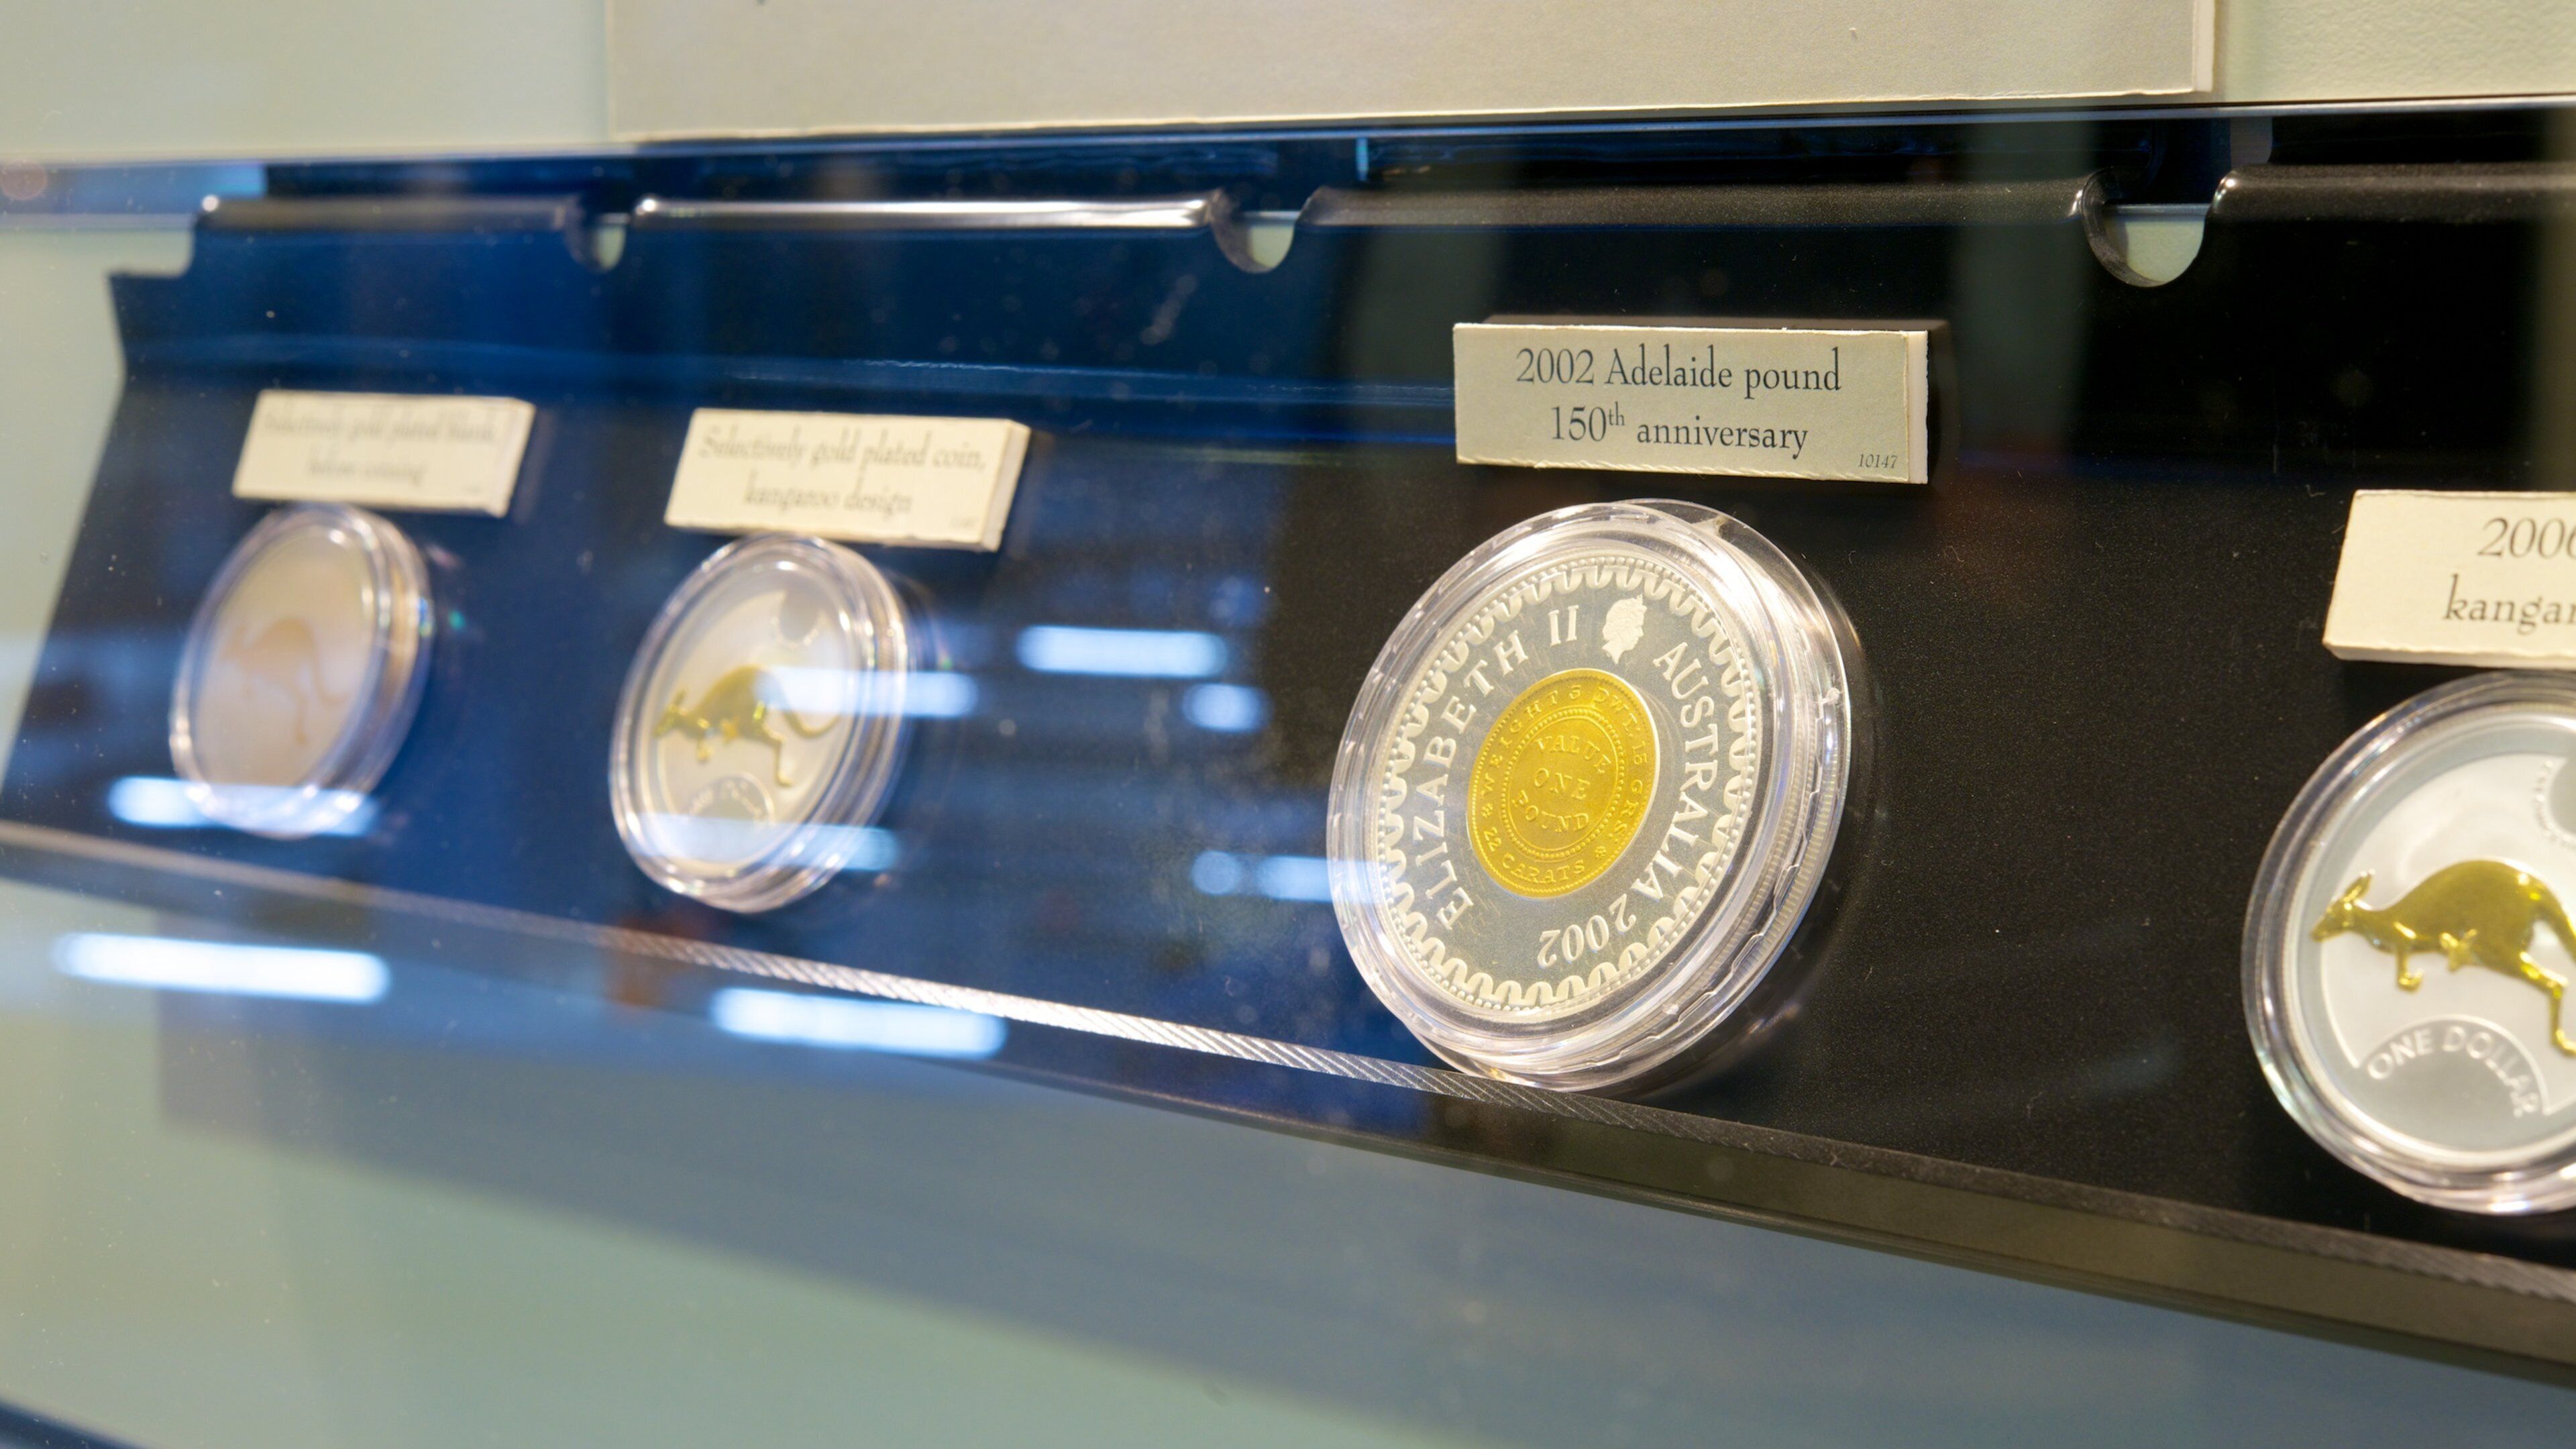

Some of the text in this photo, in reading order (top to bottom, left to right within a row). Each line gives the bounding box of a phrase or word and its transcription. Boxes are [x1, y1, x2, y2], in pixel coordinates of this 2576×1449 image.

[1515, 343, 1842, 400] 2002 Adelaide pound
[808, 426, 862, 471] gold
[859, 429, 932, 474] plated
[1550, 400, 1809, 460] 150th anniversary
[1858, 453, 1898, 468] 10147
[743, 468, 912, 522] kangaroo design
[1412, 604, 1579, 930] ELIZABETH II
[1534, 735, 1611, 774] VALUE
[1534, 767, 1591, 801] ONE
[1537, 641, 1719, 969] AUSTRALIA 2002
[1511, 789, 1590, 833] POUND
[1502, 852, 1586, 884] CARATS
[2367, 1025, 2539, 1118] ONE DOLLAR
